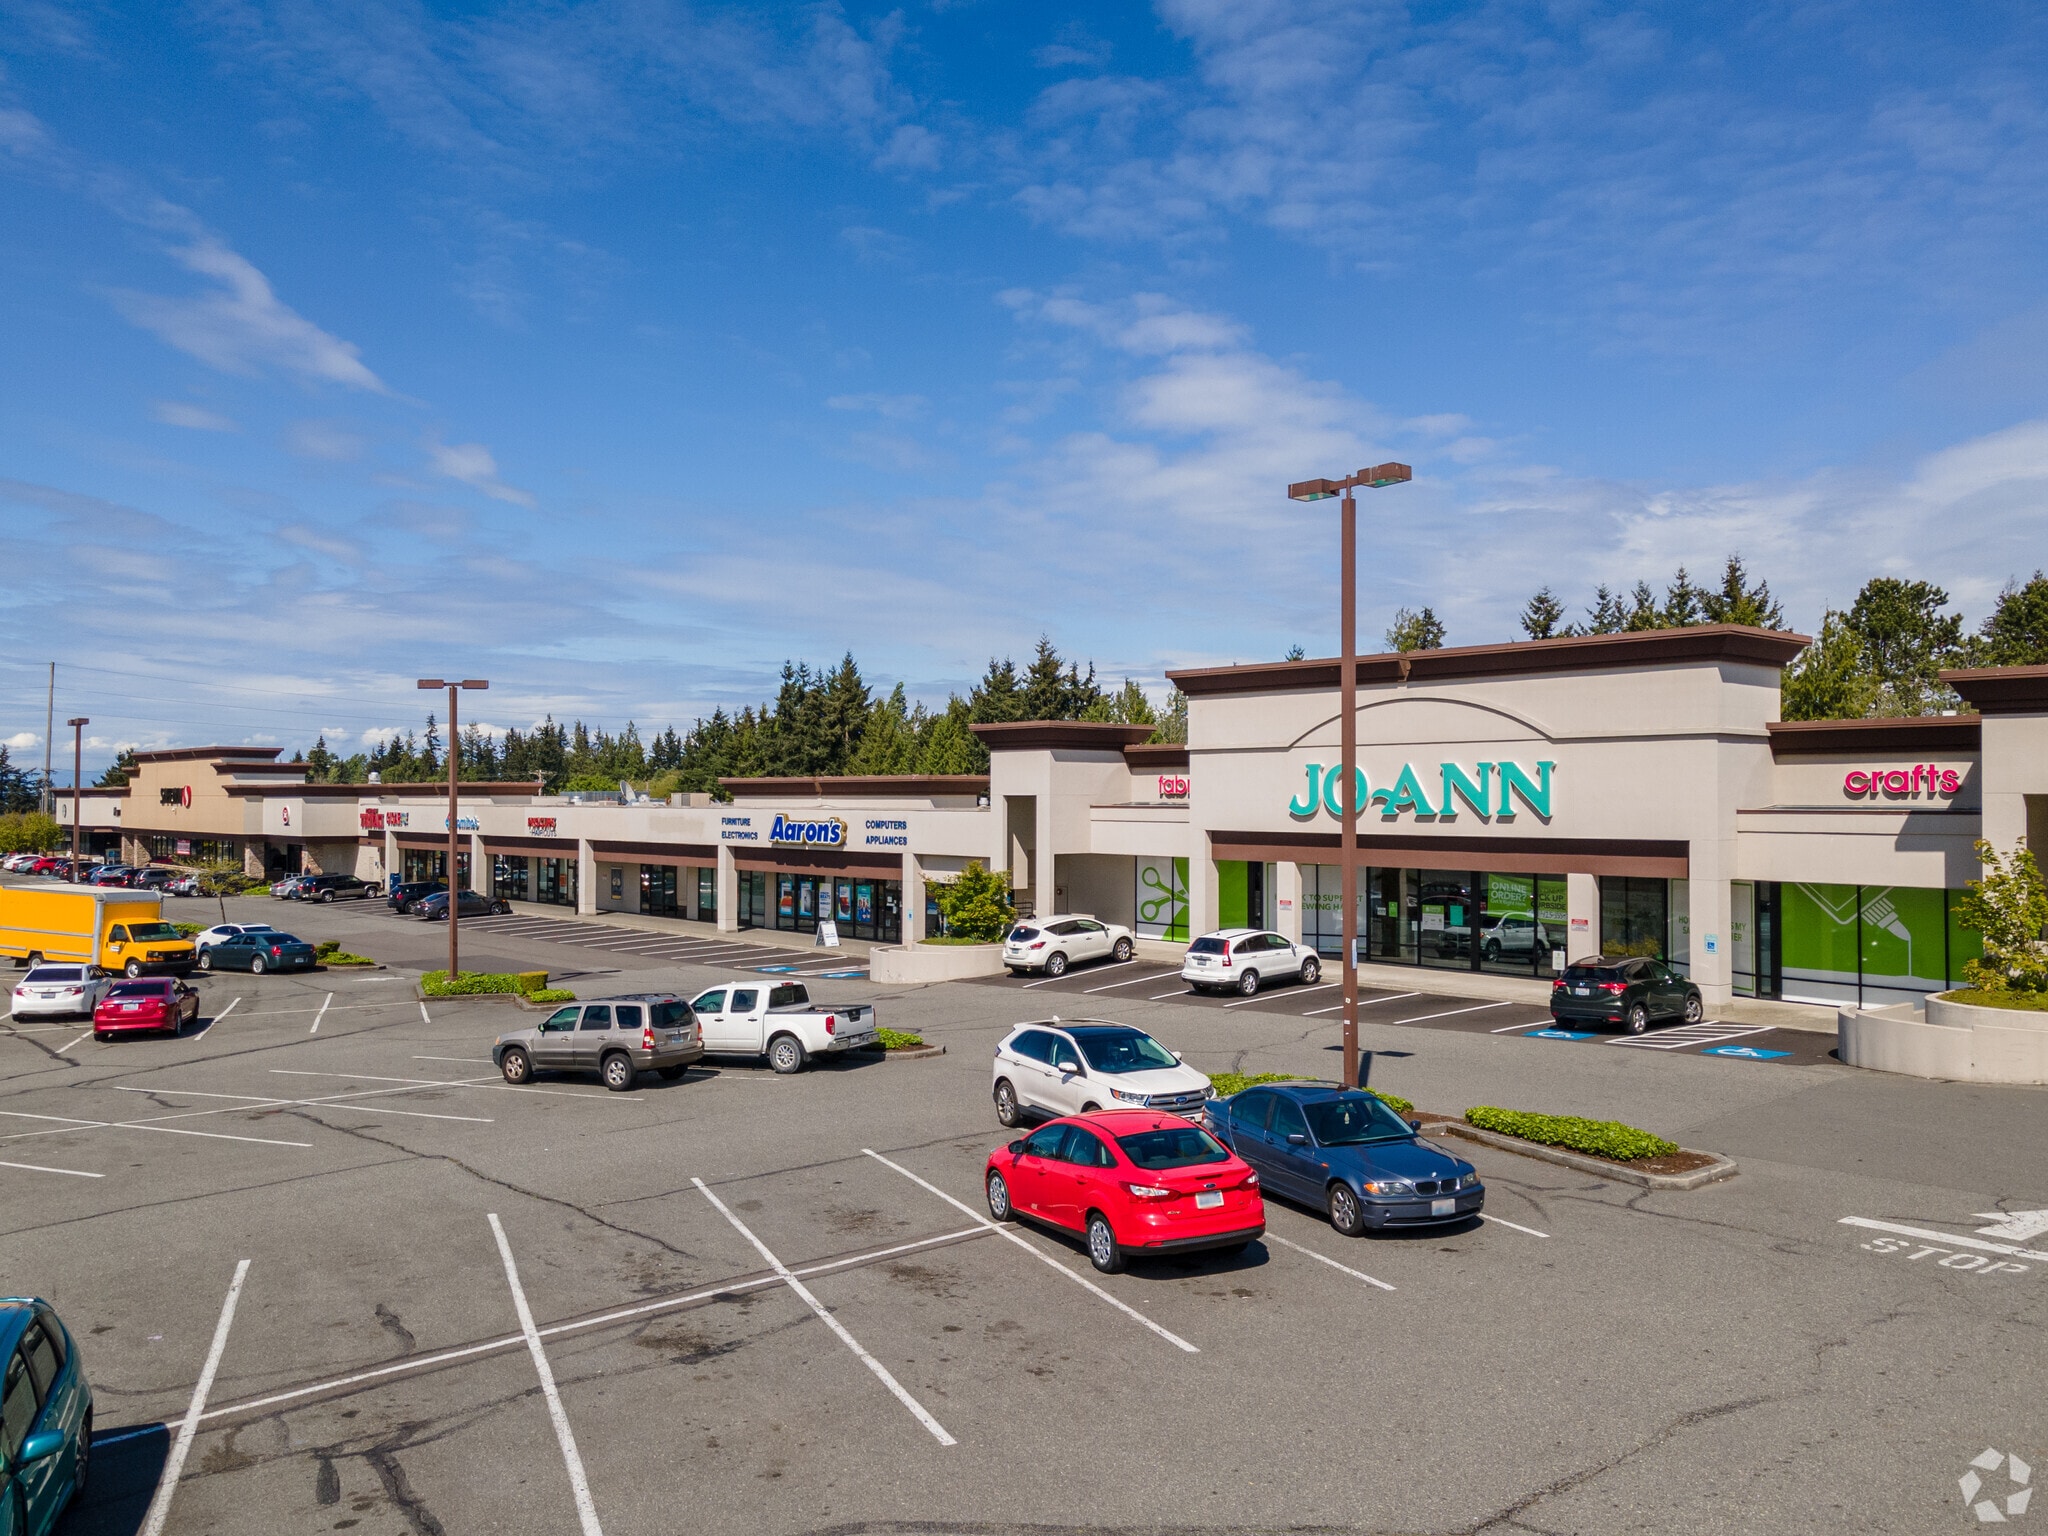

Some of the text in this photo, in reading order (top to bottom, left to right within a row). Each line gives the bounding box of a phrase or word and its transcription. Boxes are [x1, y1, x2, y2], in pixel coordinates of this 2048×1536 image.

[1844, 763, 1960, 794] crafts
[721, 817, 751, 827] FURNITURE
[865, 819, 907, 831] COMPUTERS
[769, 814, 843, 844] Aaron's
[721, 830, 758, 841] ELECTRONICS
[865, 835, 908, 846] APPLIANCES
[1491, 881, 1527, 894] ONLINE
[1322, 894, 1364, 902] SUPPT
[1490, 890, 1527, 902] ORDER?
[1552, 894, 1564, 903] UP
[1302, 903, 1332, 911] EWING
[1860, 1237, 2032, 1274] STOP
